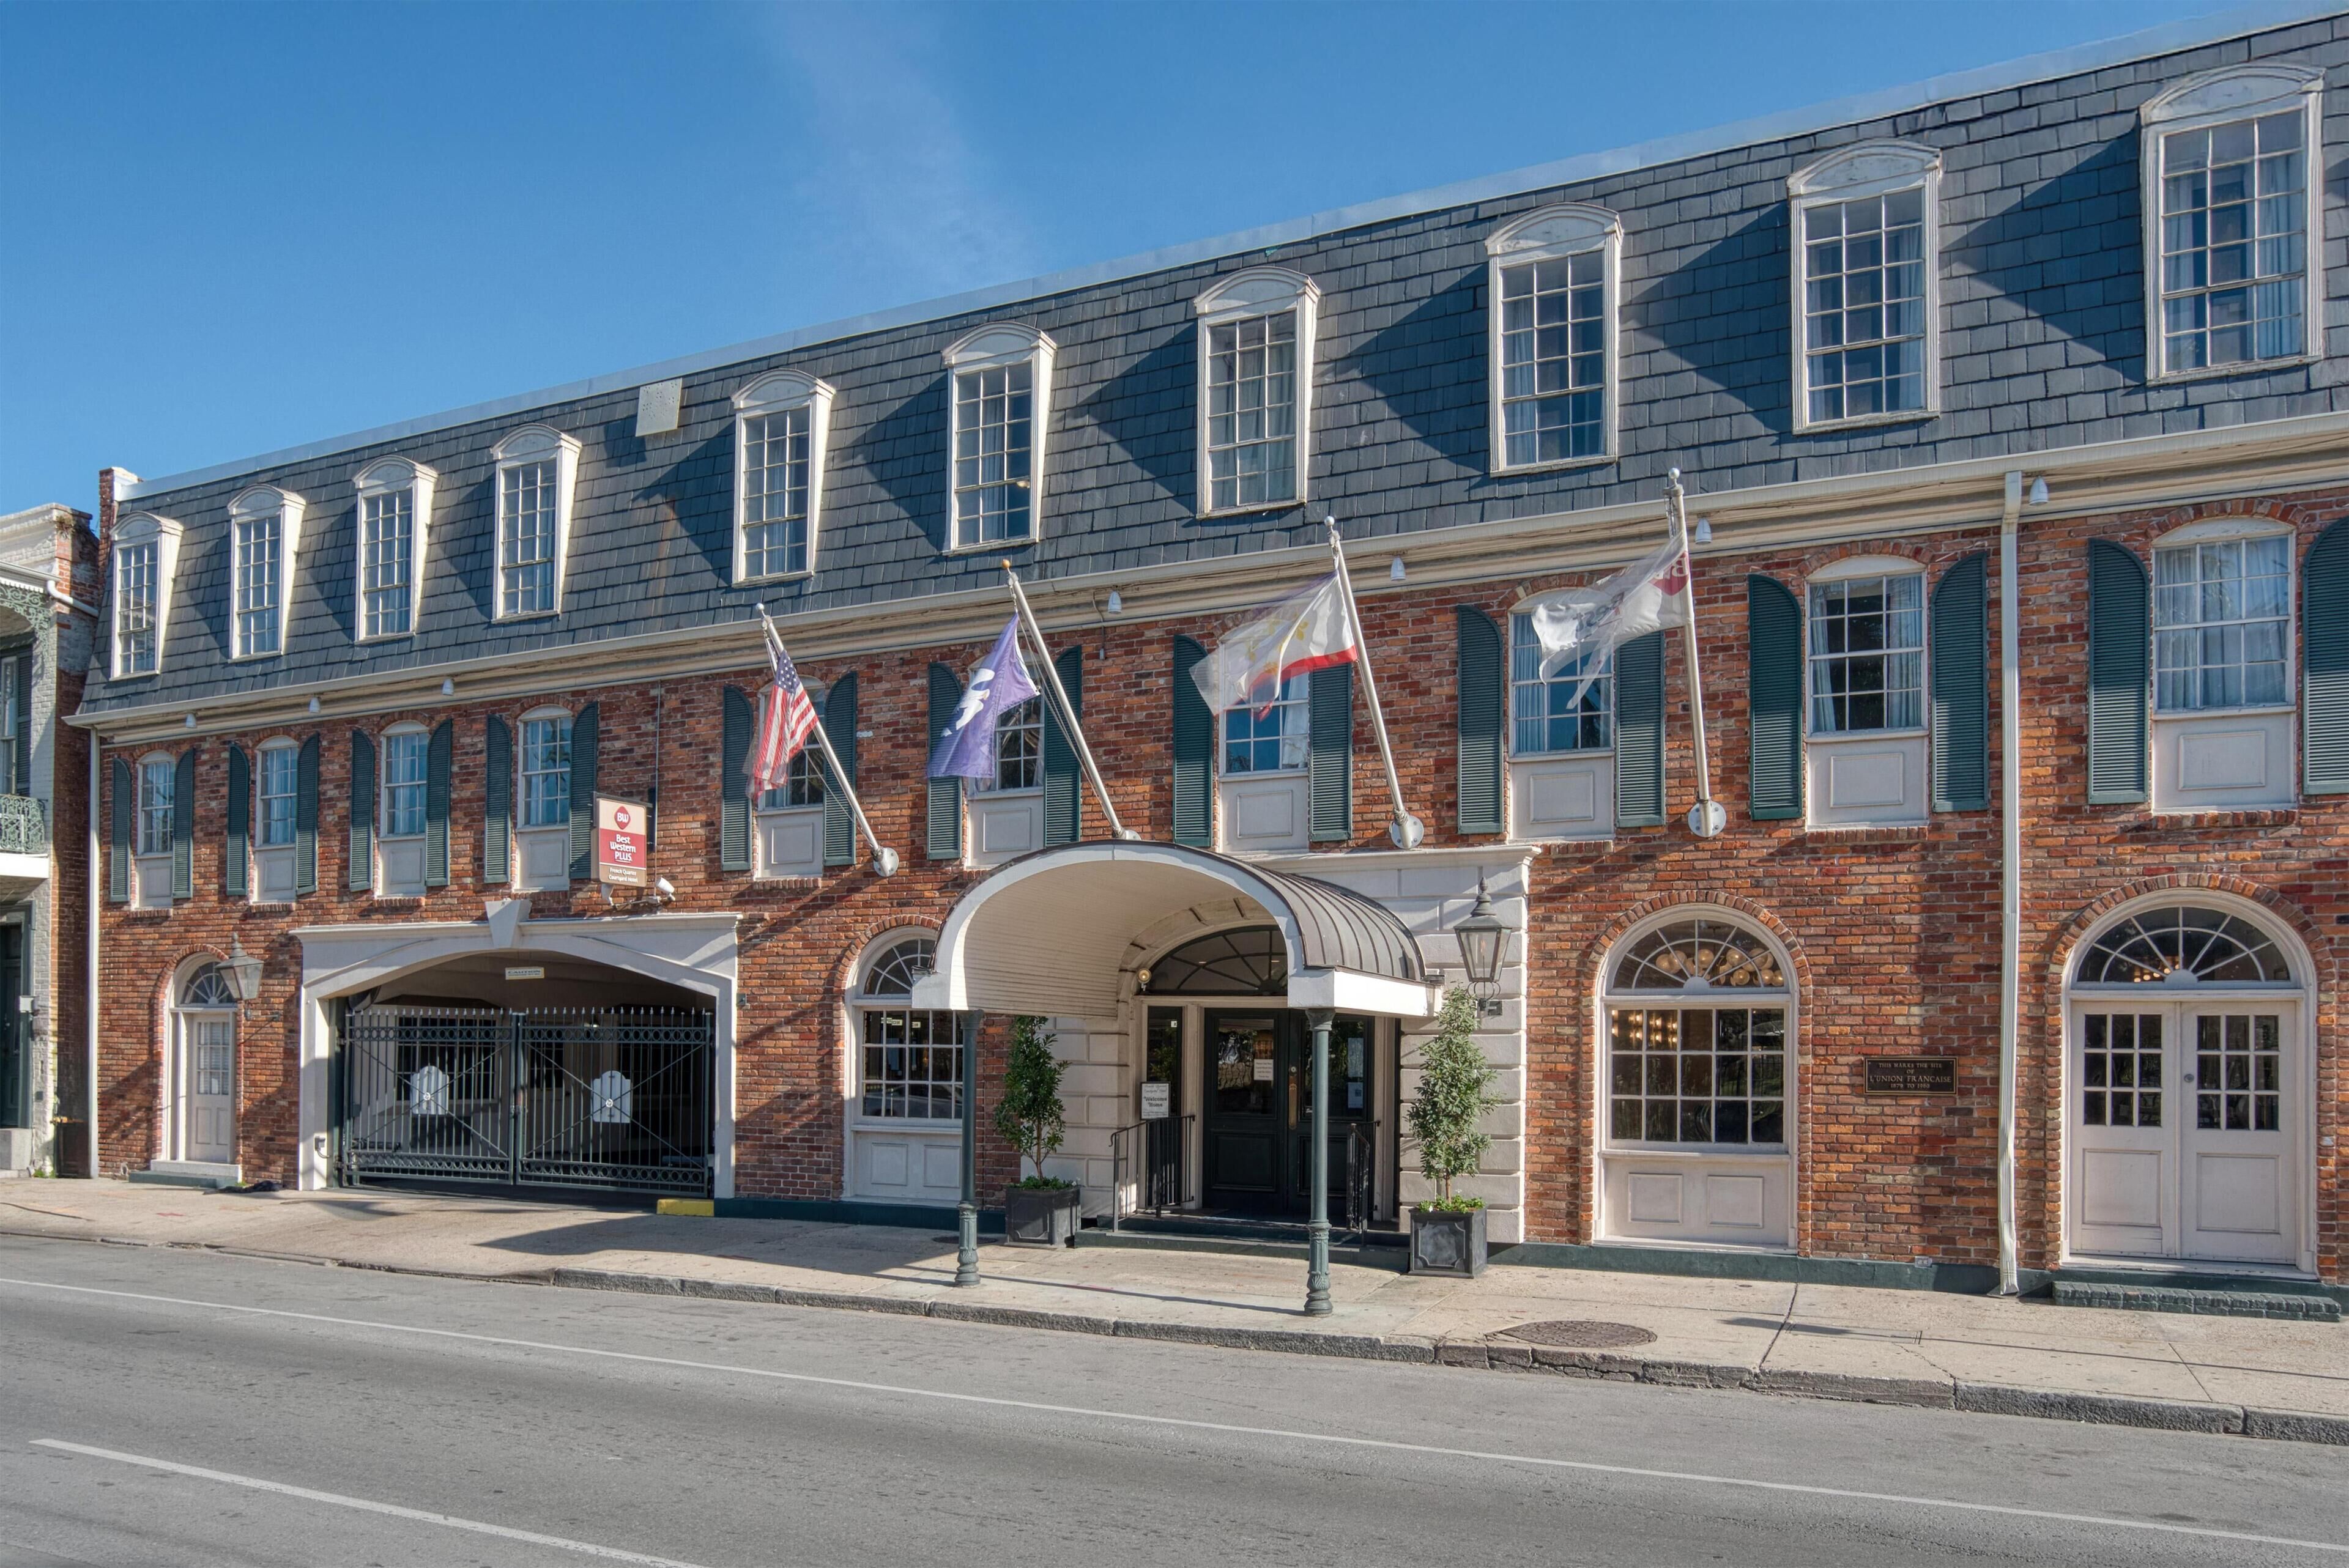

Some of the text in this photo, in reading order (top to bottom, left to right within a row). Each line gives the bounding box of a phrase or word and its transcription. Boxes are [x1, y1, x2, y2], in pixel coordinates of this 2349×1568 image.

[617, 812, 629, 823] BW
[616, 834, 631, 844] Best
[609, 841, 636, 853] Western
[615, 851, 631, 861] PLUS
